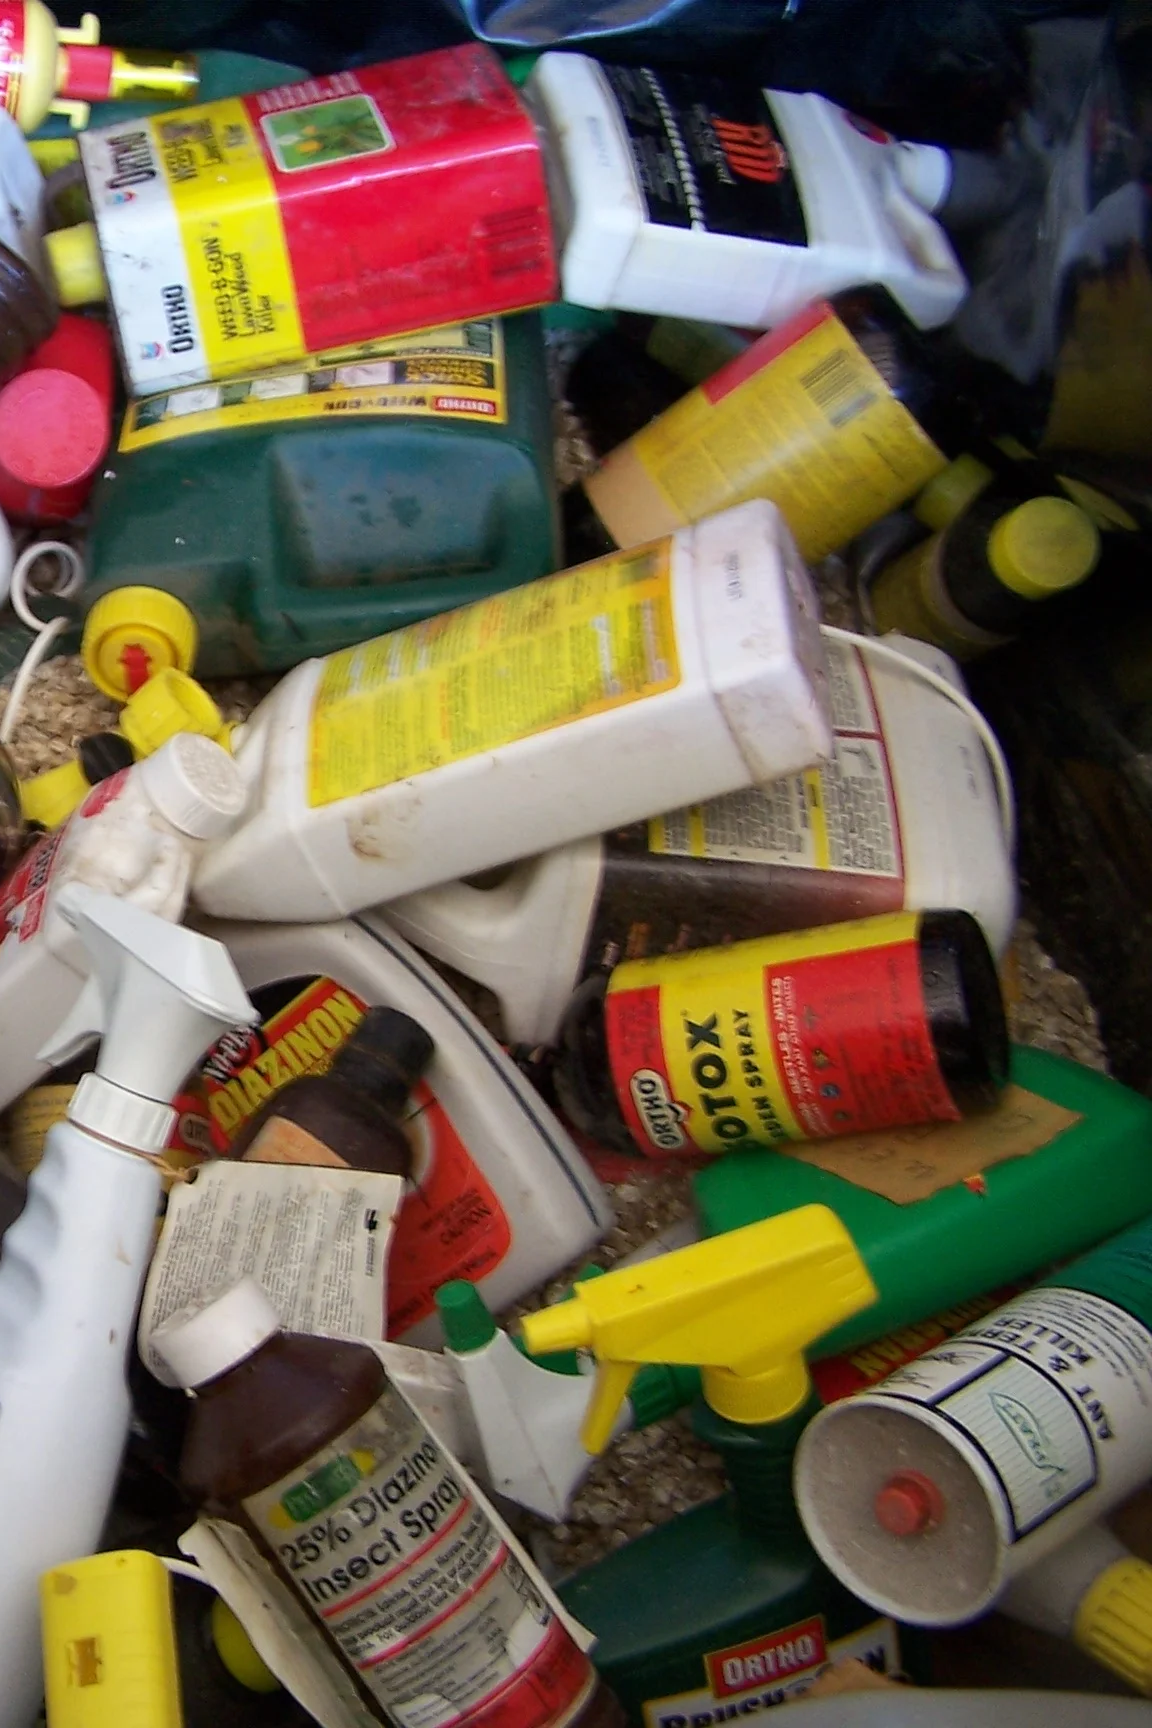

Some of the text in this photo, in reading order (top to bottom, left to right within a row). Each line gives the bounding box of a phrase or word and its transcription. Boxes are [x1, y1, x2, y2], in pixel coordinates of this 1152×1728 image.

[107, 131, 156, 189] ORTHO
[162, 285, 196, 354] ORTHO
[206, 988, 367, 1137] DIAZINON
[683, 1010, 750, 1152] OTOX
[732, 1009, 765, 1089] SPRAY
[635, 1076, 681, 1149] ORTHO
[991, 1315, 1095, 1368] KILLER
[1048, 1354, 1074, 1376] &
[1069, 1383, 1117, 1443] ANT
[277, 1511, 353, 1571] 25%
[346, 1435, 440, 1531] Diazino
[299, 1527, 403, 1604] Insect
[402, 1474, 464, 1542] Spray
[718, 1632, 822, 1688] ORTHO
